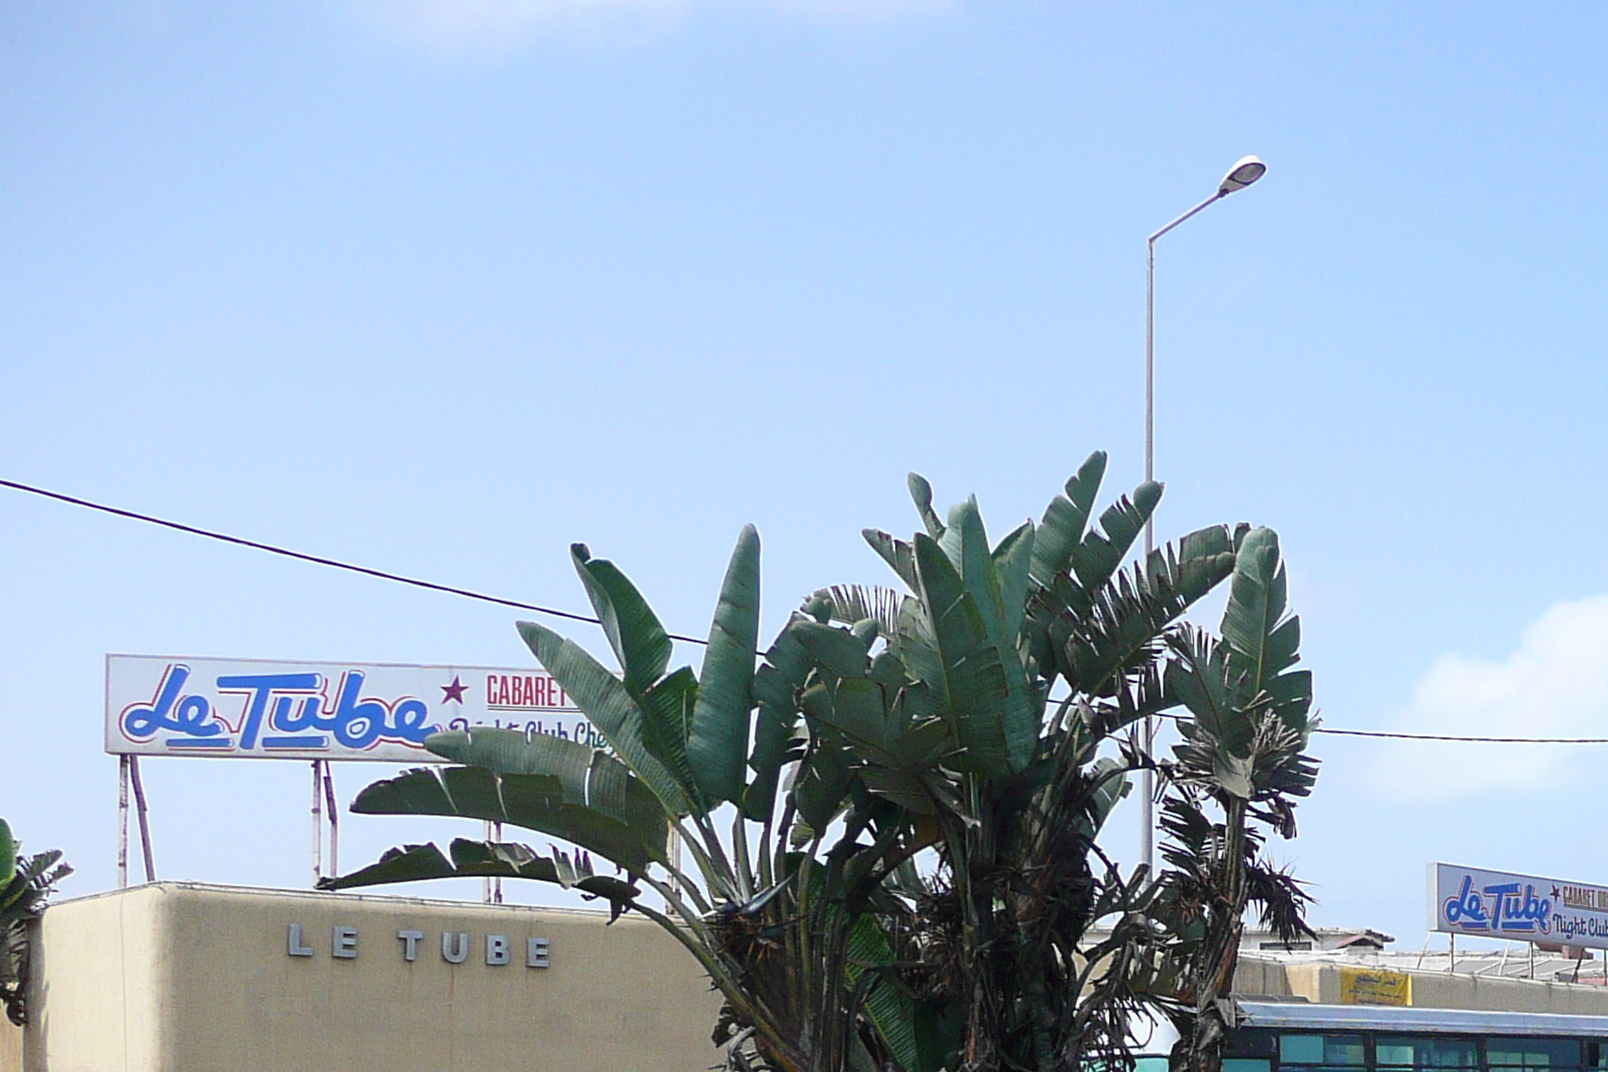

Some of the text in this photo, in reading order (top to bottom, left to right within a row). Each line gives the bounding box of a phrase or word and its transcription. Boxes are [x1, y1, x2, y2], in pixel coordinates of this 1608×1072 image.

[121, 663, 439, 750] Le Tube
[574, 721, 616, 756] Che
[1443, 875, 1550, 932] Le Tube
[1563, 886, 1595, 907] CABARET
[288, 923, 549, 968] LE TUBE
[1553, 913, 1586, 939] Night
